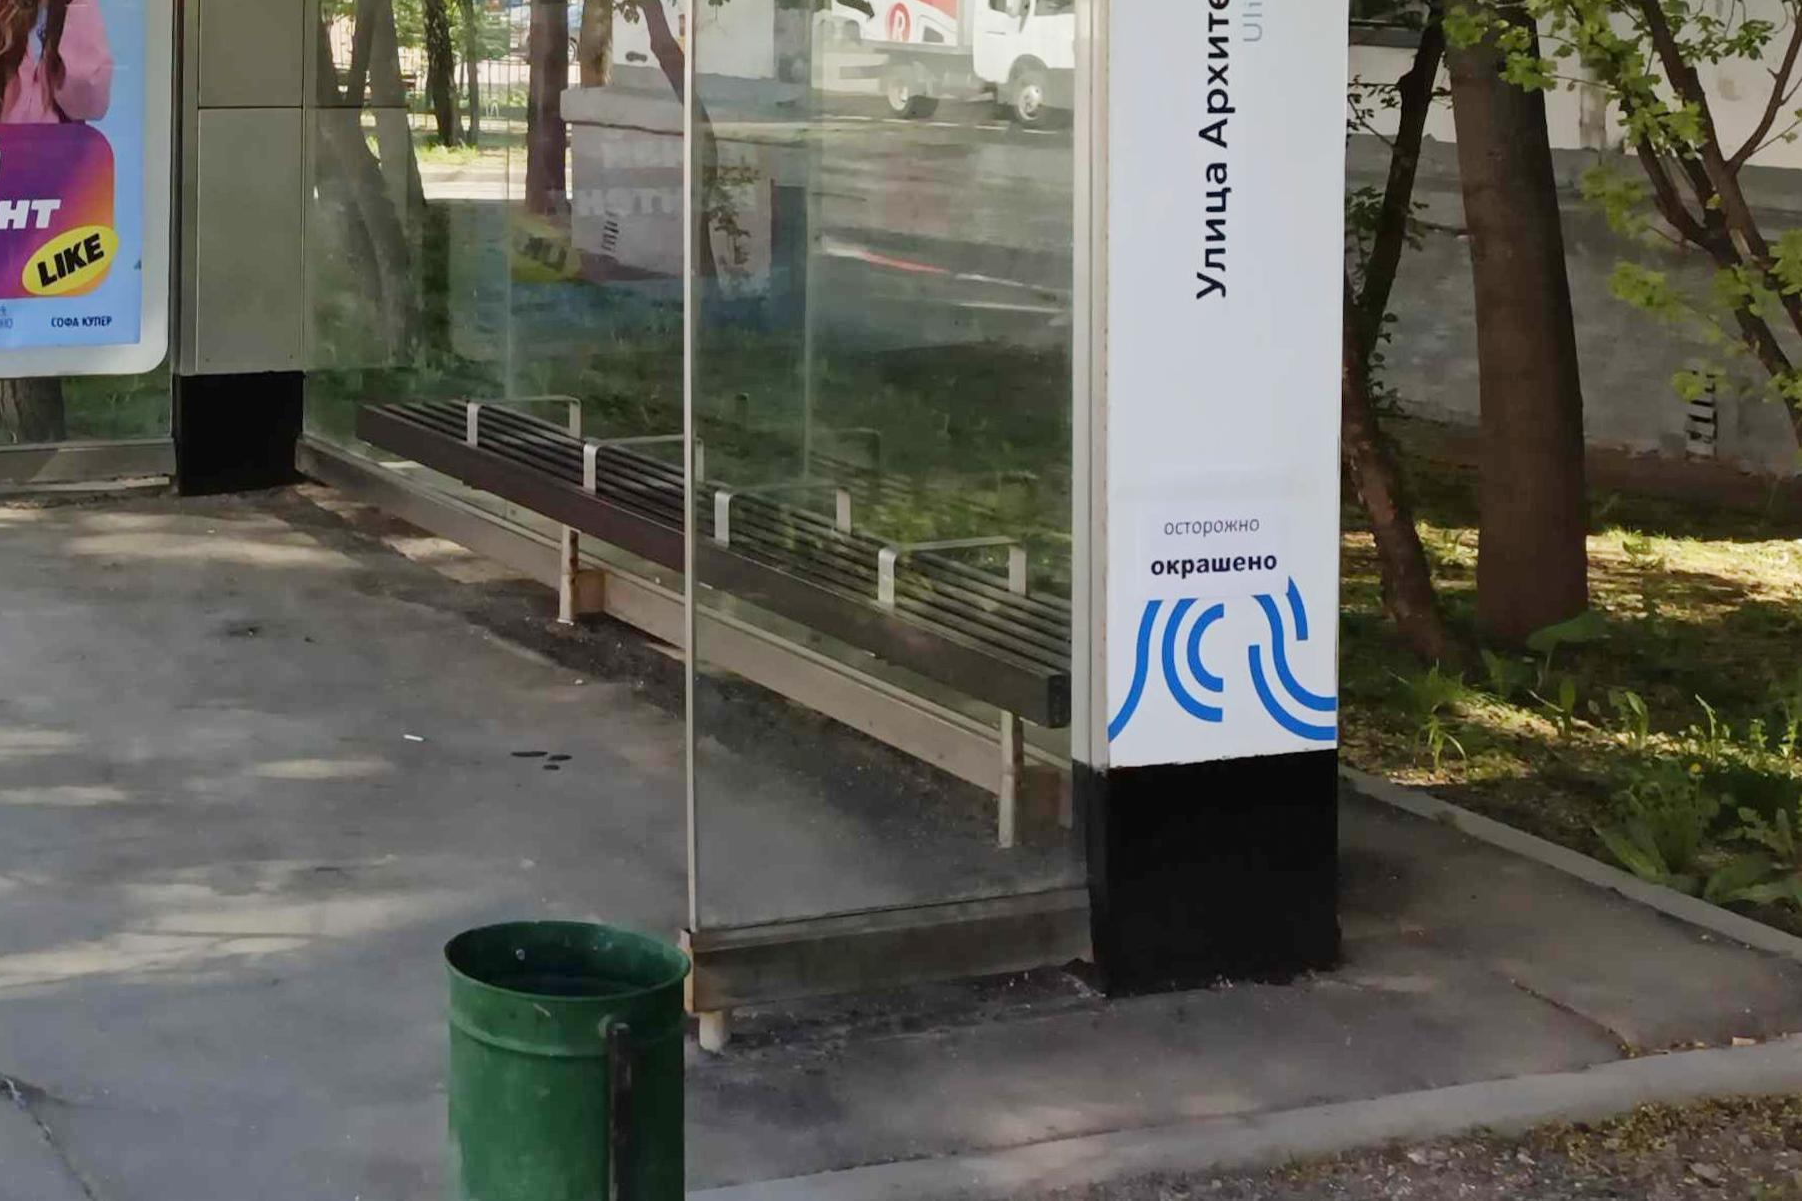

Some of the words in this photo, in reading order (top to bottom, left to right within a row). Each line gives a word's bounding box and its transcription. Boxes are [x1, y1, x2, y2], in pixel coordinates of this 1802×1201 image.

[1196, 161, 1232, 299] Улица
[36, 233, 105, 288] LIKE
[51, 317, 79, 328] СОФА
[82, 315, 112, 327] КУПЕР
[1163, 516, 1260, 538] осторожно
[1150, 552, 1278, 579] окрашено
